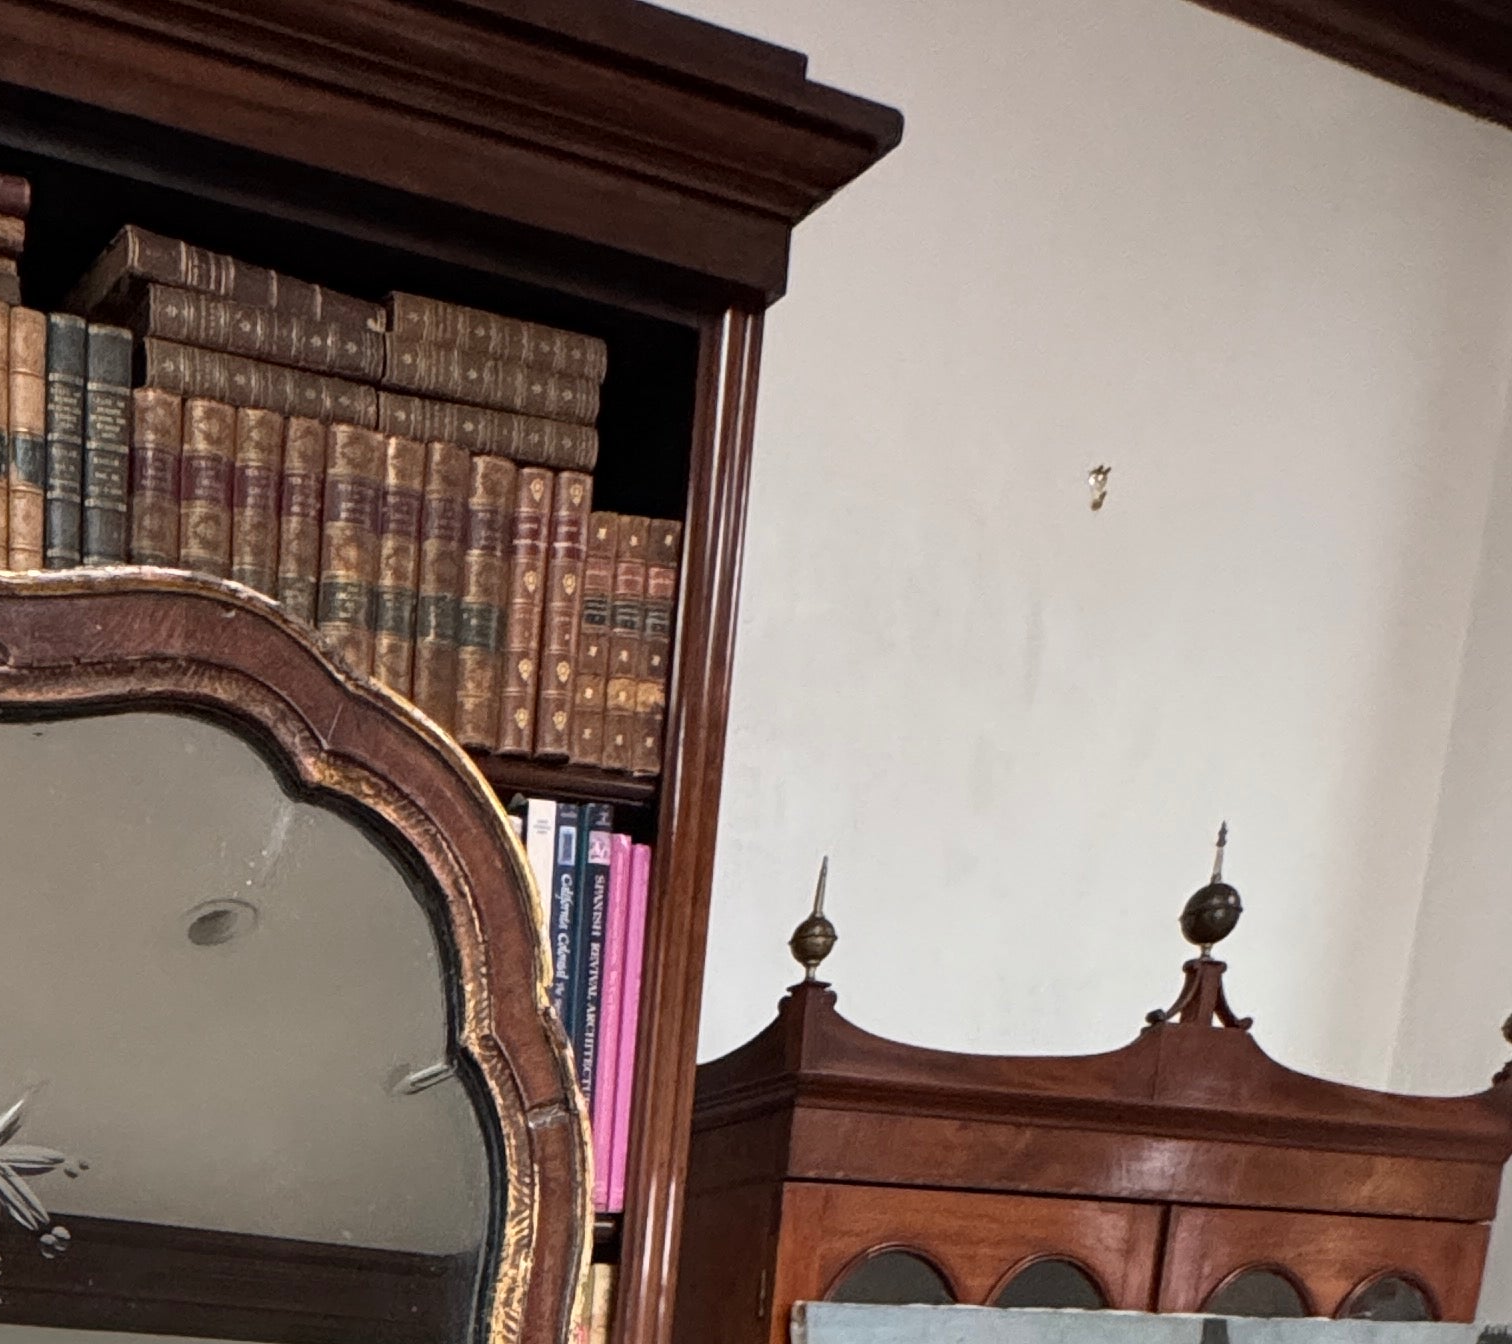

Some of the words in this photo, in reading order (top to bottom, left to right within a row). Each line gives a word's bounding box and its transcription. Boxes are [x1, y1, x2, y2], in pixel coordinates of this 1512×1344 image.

[556, 873, 575, 930] California
[591, 874, 606, 937] SPANISH
[556, 933, 571, 980] Colonial
[587, 941, 602, 1000] REVIVAL
